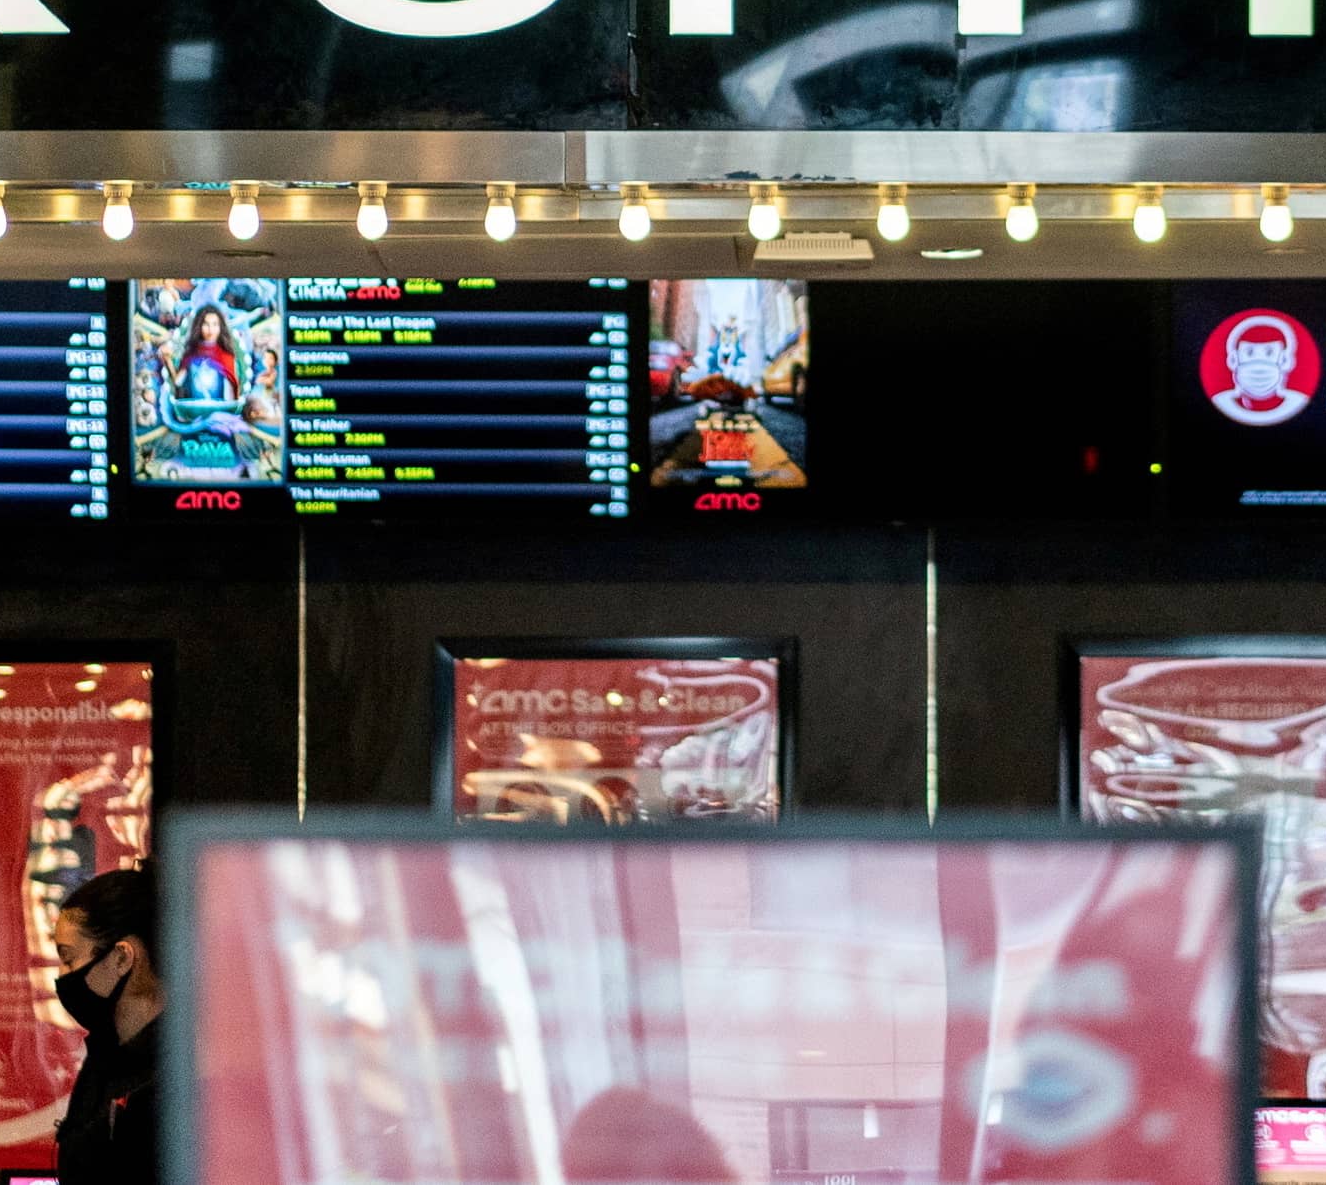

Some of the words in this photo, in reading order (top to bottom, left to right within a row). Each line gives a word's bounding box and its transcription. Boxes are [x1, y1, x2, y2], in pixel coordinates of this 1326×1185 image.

[288, 286, 347, 301] CINEMA
[344, 316, 365, 328] The
[393, 316, 436, 330] Dragon
[290, 419, 312, 432] The
[313, 419, 351, 432] Father
[290, 453, 312, 466] The
[313, 453, 371, 466] Marksman
[176, 491, 241, 511] amc
[290, 487, 312, 500] The
[313, 487, 381, 501] Mauritanian
[694, 492, 762, 511] amc
[481, 689, 571, 713] amc
[638, 690, 660, 713] &
[665, 690, 748, 713] Clean
[539, 721, 575, 735] BOX
[578, 721, 638, 736] OFFICE
